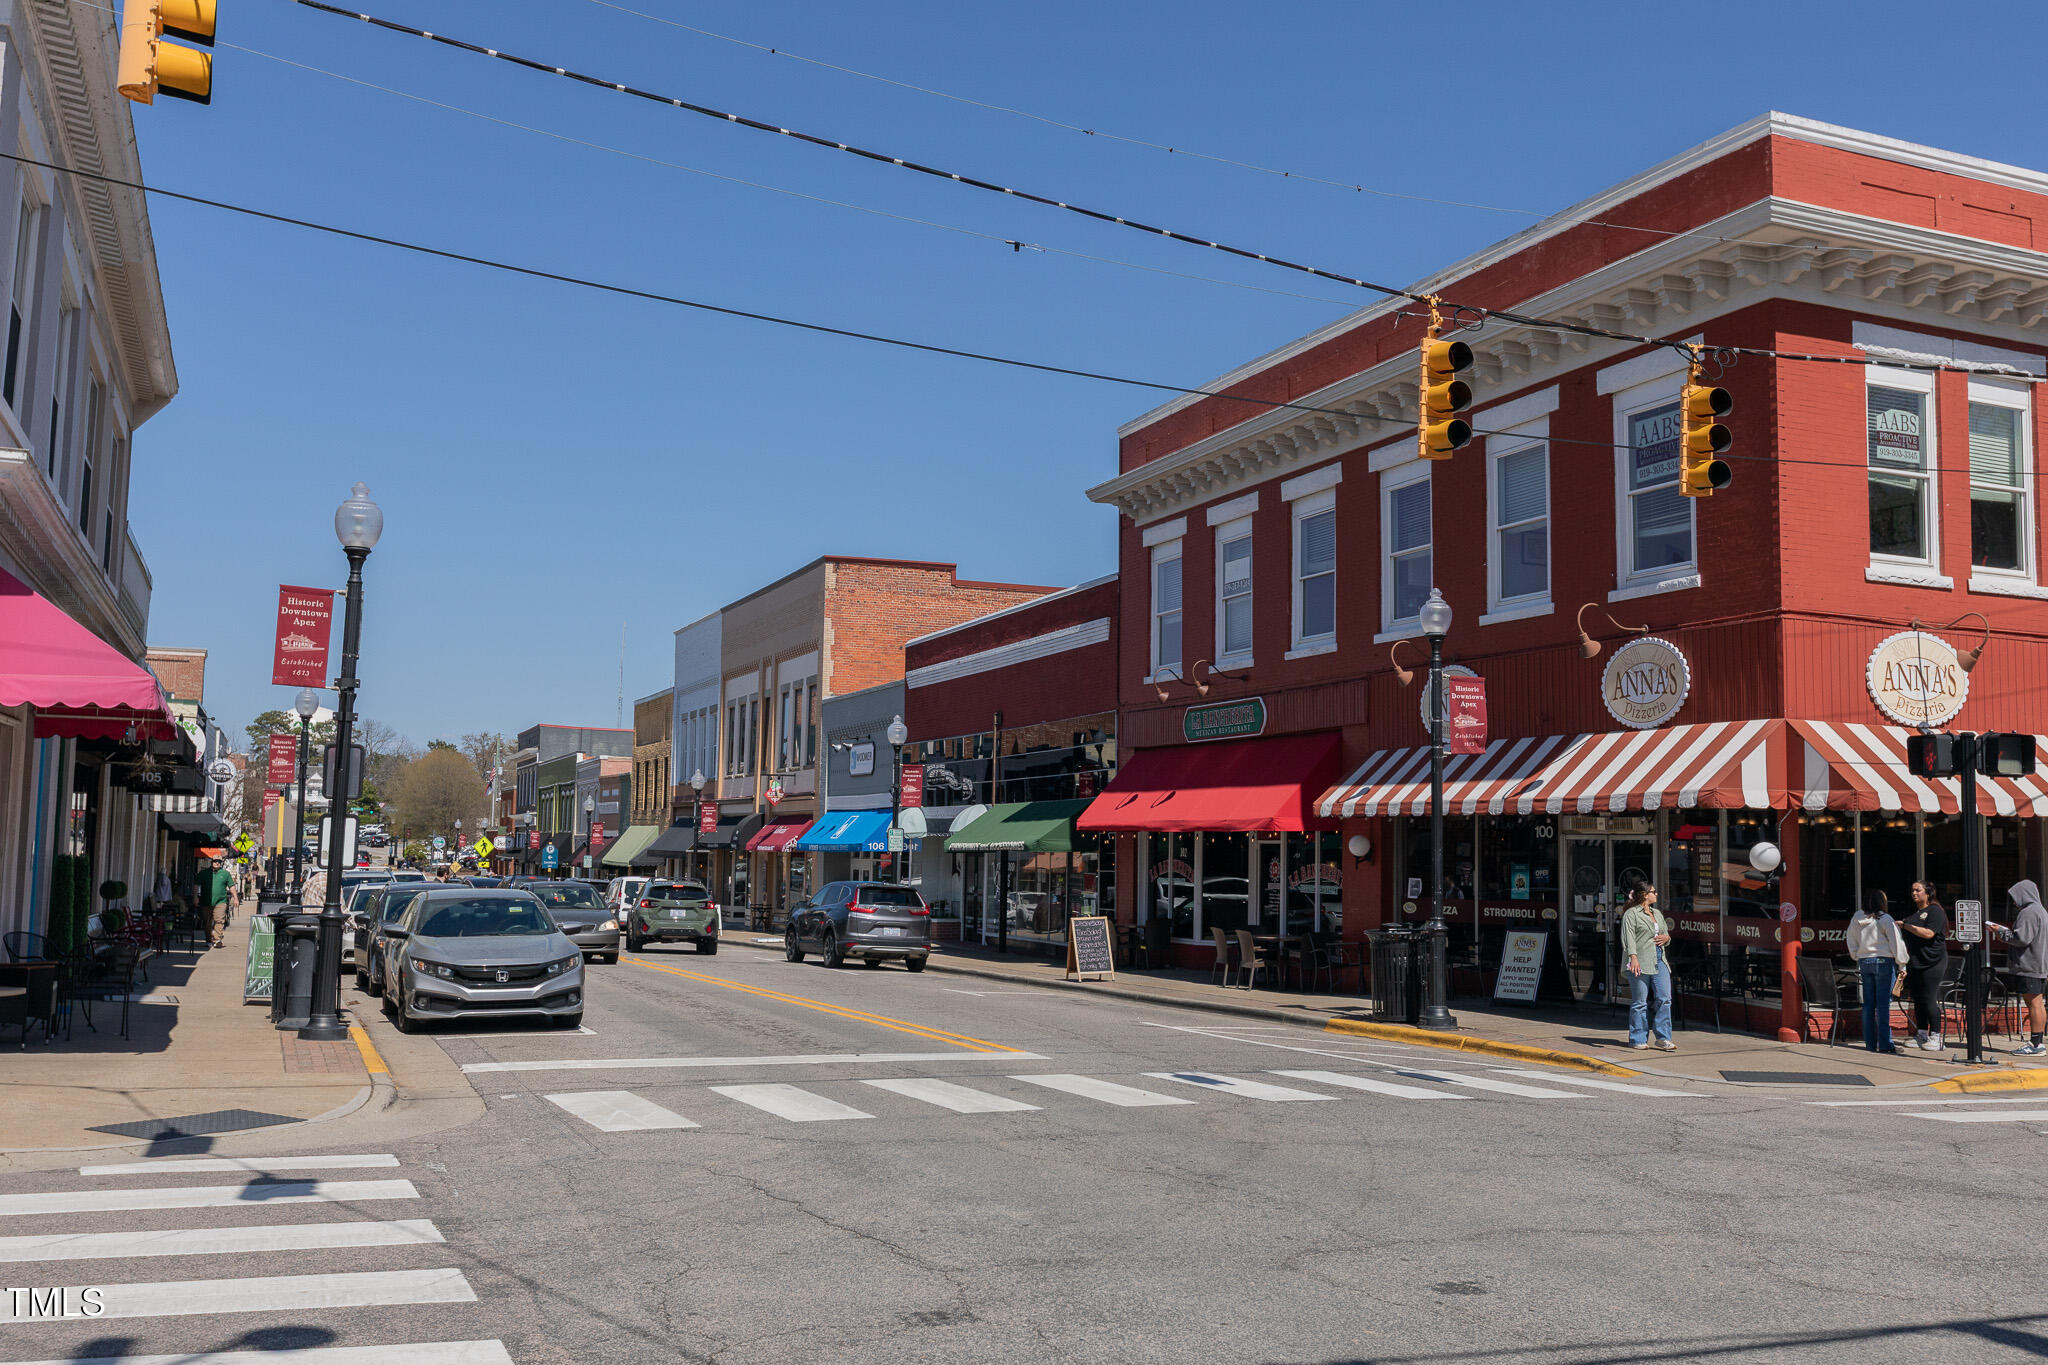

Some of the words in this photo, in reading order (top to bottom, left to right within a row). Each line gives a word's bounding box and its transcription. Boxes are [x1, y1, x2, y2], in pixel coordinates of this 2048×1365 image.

[1880, 411, 1917, 434] AABS
[1639, 413, 1681, 447] AABS
[1880, 432, 1917, 445] PROACTIVE
[1640, 438, 1680, 458] PROACTIV
[1639, 460, 1679, 479] 919-303-334
[287, 597, 324, 607] Historic
[281, 606, 329, 618] Downtown
[293, 617, 316, 627] Apex
[281, 657, 323, 667] Established
[1612, 662, 1678, 701] ANNA'S
[1881, 660, 1957, 698] ANNA'S
[1455, 685, 1480, 693] Historic
[1451, 692, 1484, 700] Downtown
[1460, 701, 1477, 709] Apex
[1622, 701, 1668, 720] Pizzeria
[1894, 696, 1946, 719] Pizzeria
[140, 772, 162, 783] 105
[1534, 825, 1554, 838] 100
[867, 842, 885, 851] 106
[1443, 906, 1458, 916] ZZA
[1483, 907, 1536, 919] STROMBOLI
[1680, 920, 1716, 934] CALZONES
[1736, 925, 1761, 938] PASTA
[1513, 956, 1532, 964] HELP
[1505, 965, 1537, 974] WANTED
